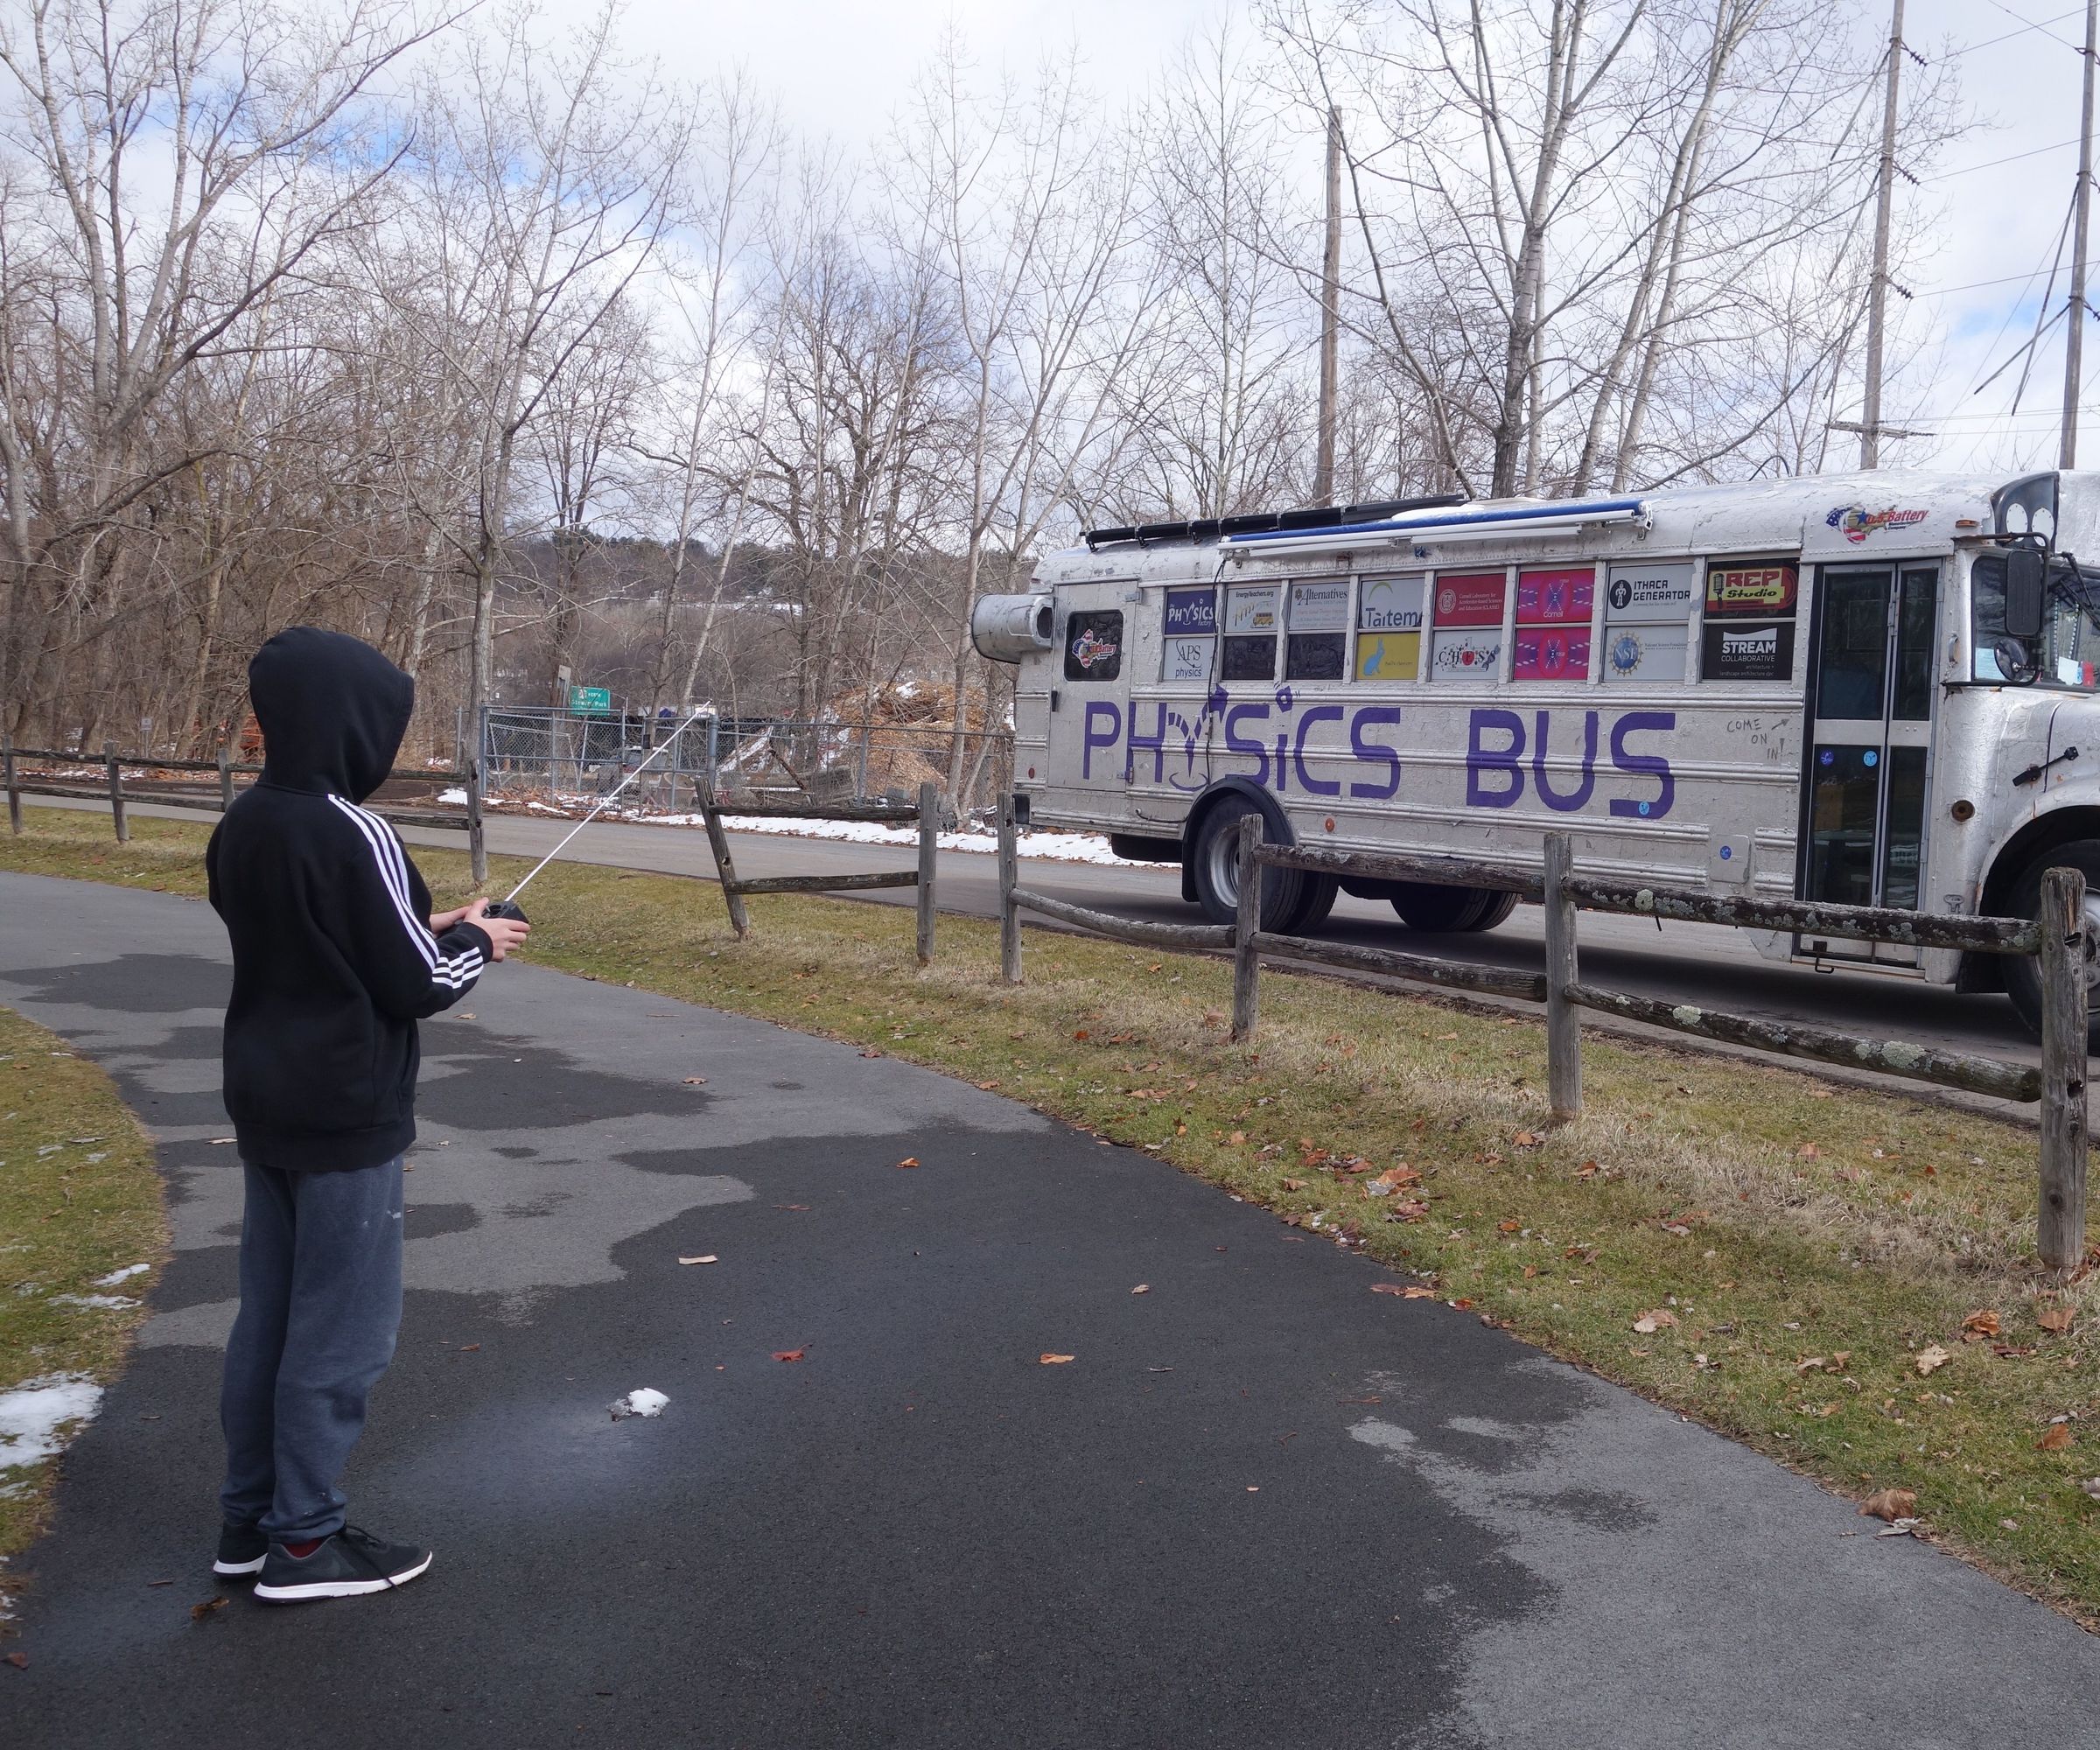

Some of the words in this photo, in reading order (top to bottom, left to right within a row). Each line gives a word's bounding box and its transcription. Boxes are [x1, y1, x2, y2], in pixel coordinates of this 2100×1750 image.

[1887, 509, 1929, 523] Battery
[1634, 579, 1669, 590] ITHACA
[1726, 570, 1779, 587] REP
[1297, 587, 1348, 606] Alternatives
[1633, 590, 1690, 601] GENERATOR
[1726, 589, 1777, 598] Studio
[1176, 644, 1201, 662] APS
[1614, 647, 1638, 661] NSF
[1722, 640, 1776, 654] STREAM
[1175, 667, 1202, 680] physics
[1726, 718, 1762, 733] COME
[1751, 732, 1768, 746] ON
[1466, 709, 1676, 820] BUS
